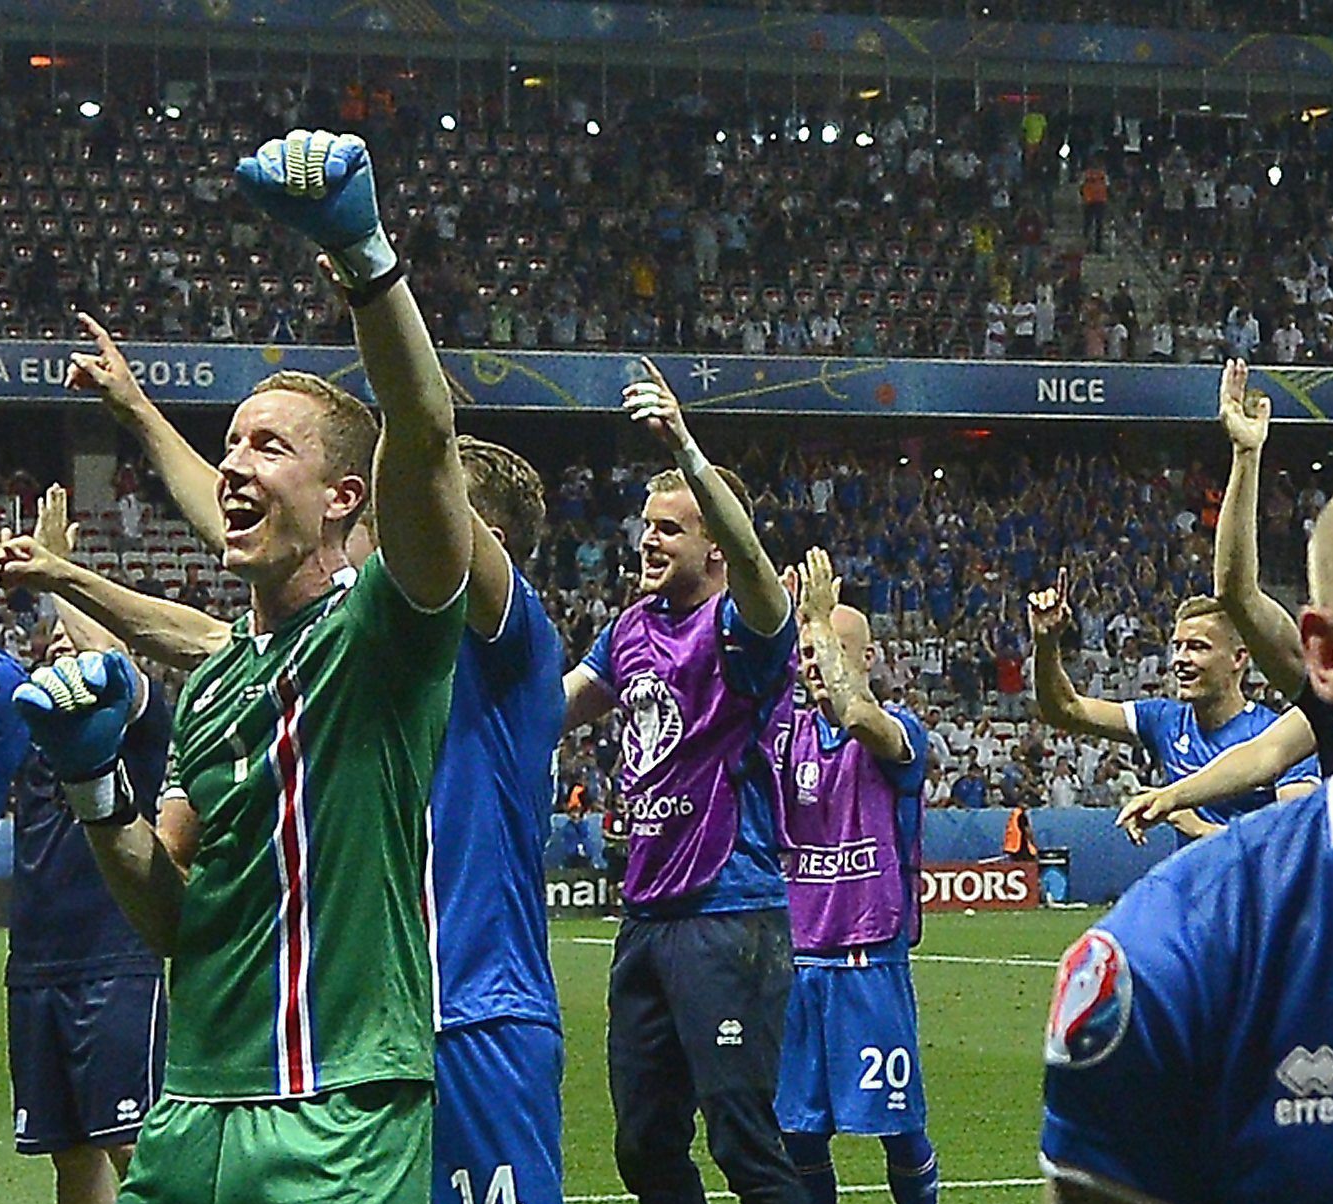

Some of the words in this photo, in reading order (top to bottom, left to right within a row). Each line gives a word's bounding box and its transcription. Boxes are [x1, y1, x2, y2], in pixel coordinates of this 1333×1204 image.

[129, 361, 215, 387] 2016
[1037, 378, 1105, 403] NICE
[920, 870, 1028, 903] OTORS
[859, 1046, 911, 1089] 20
